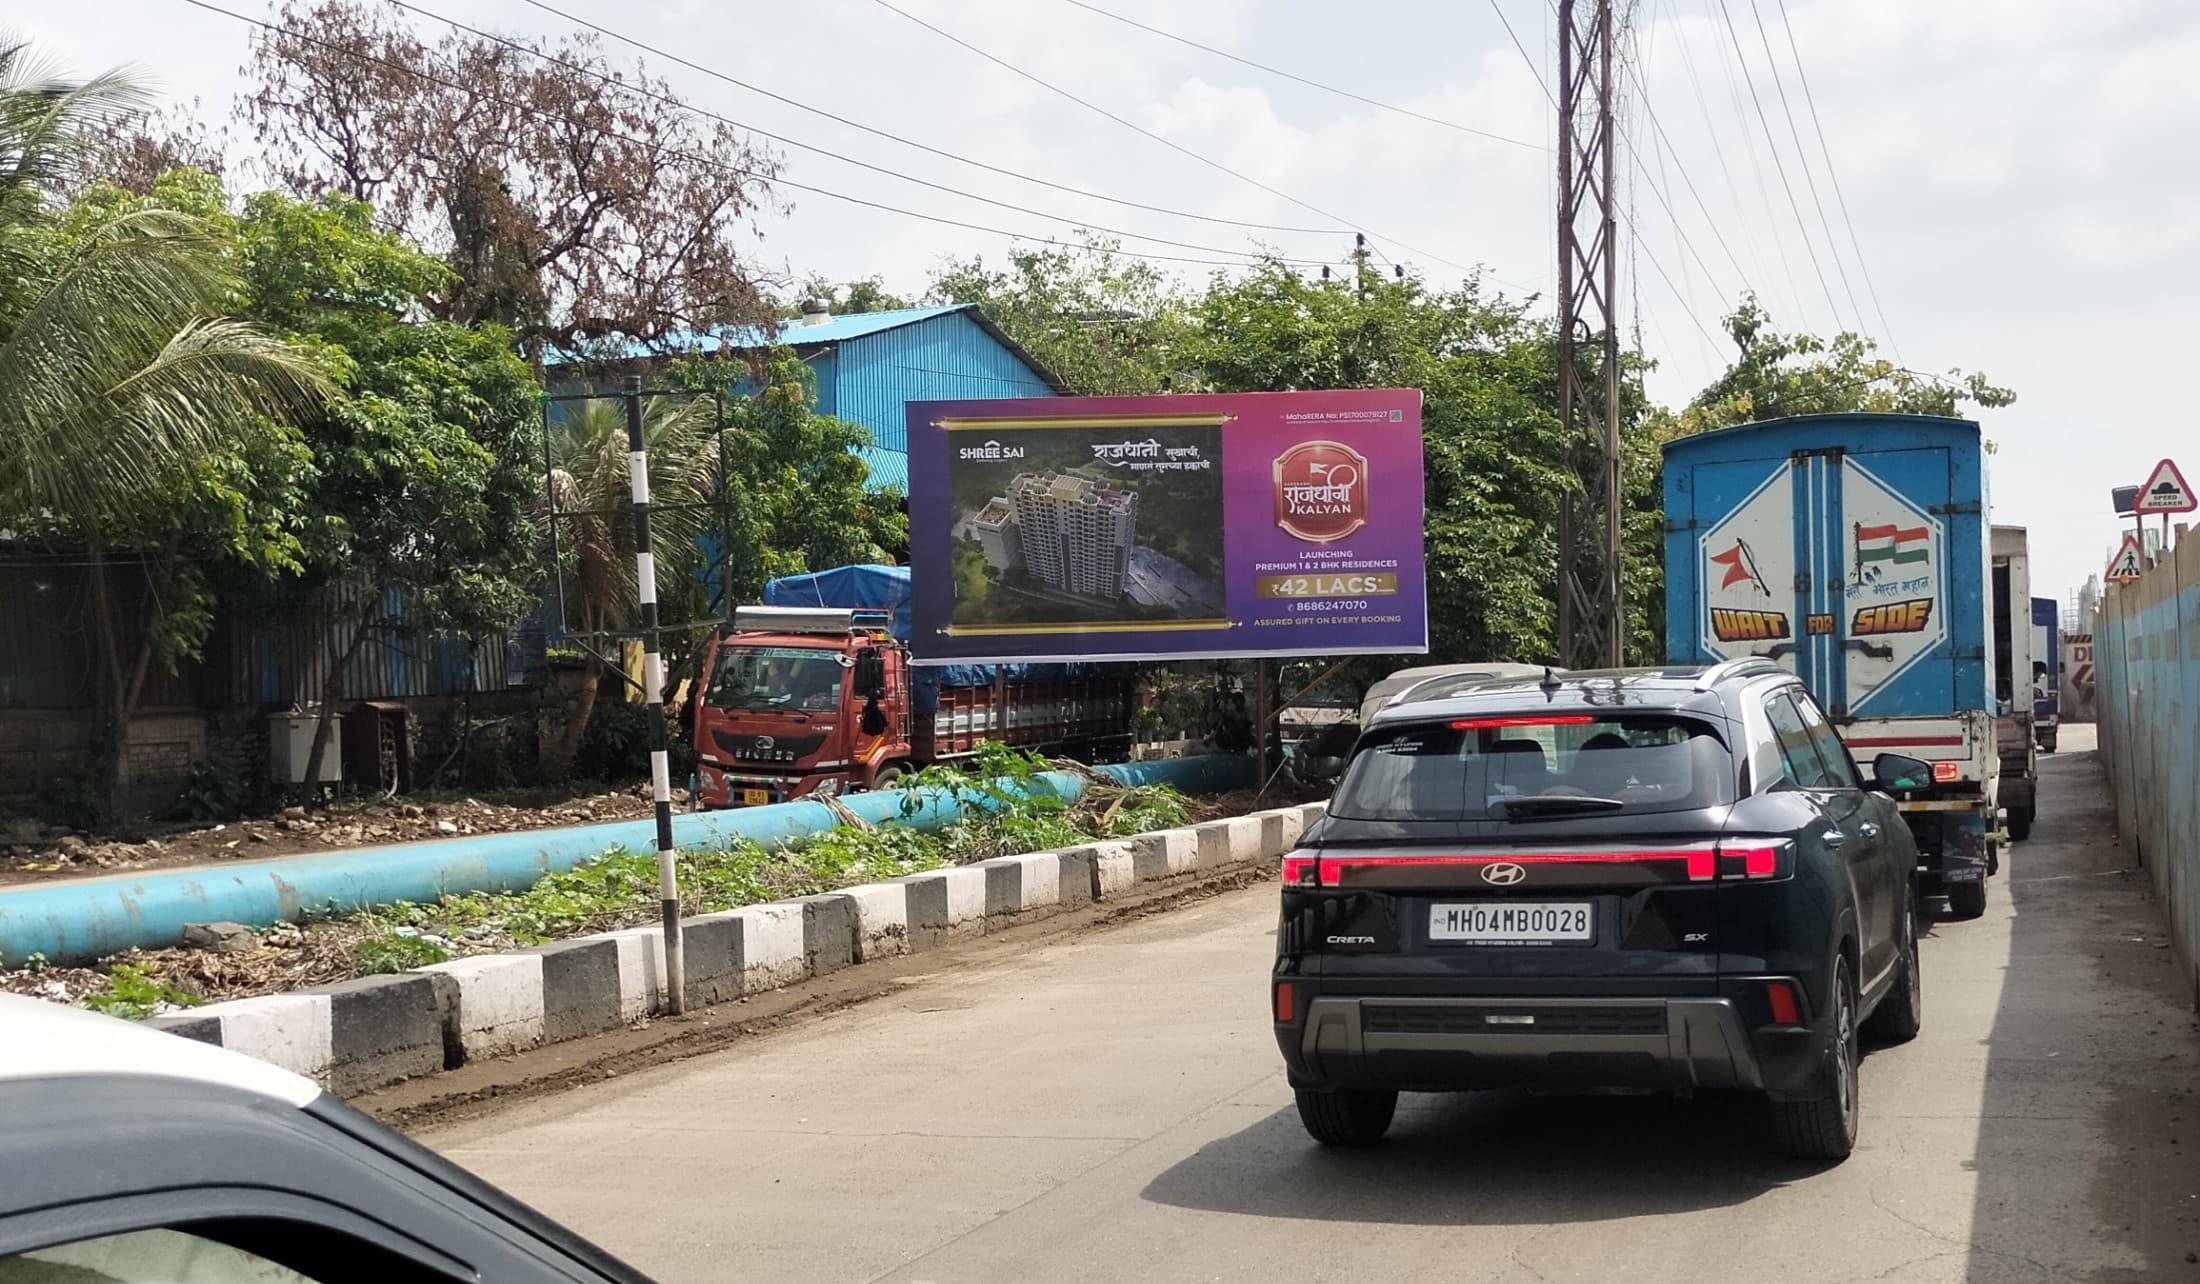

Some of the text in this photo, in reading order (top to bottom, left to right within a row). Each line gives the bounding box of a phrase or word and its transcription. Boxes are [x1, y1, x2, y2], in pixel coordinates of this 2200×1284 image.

[960, 446, 1024, 459] SHREE SAI
[1297, 504, 1352, 515] KALYAN
[1299, 550, 1353, 559] LAUNCHING
[1255, 562, 1297, 571] PREMIUM
[1321, 561, 1340, 569] BHK
[1341, 559, 1398, 568] RESIDENCES
[1296, 600, 1367, 611] 8686247070
[1254, 615, 1401, 626] ASSURED GIFT ON EVERY BOOKING
[1711, 600, 1931, 639] WAIT FOR SIDE
[1447, 909, 1586, 933] MH04MB0028
[1326, 935, 1375, 944] CRETA
[1683, 933, 1709, 942] SX
